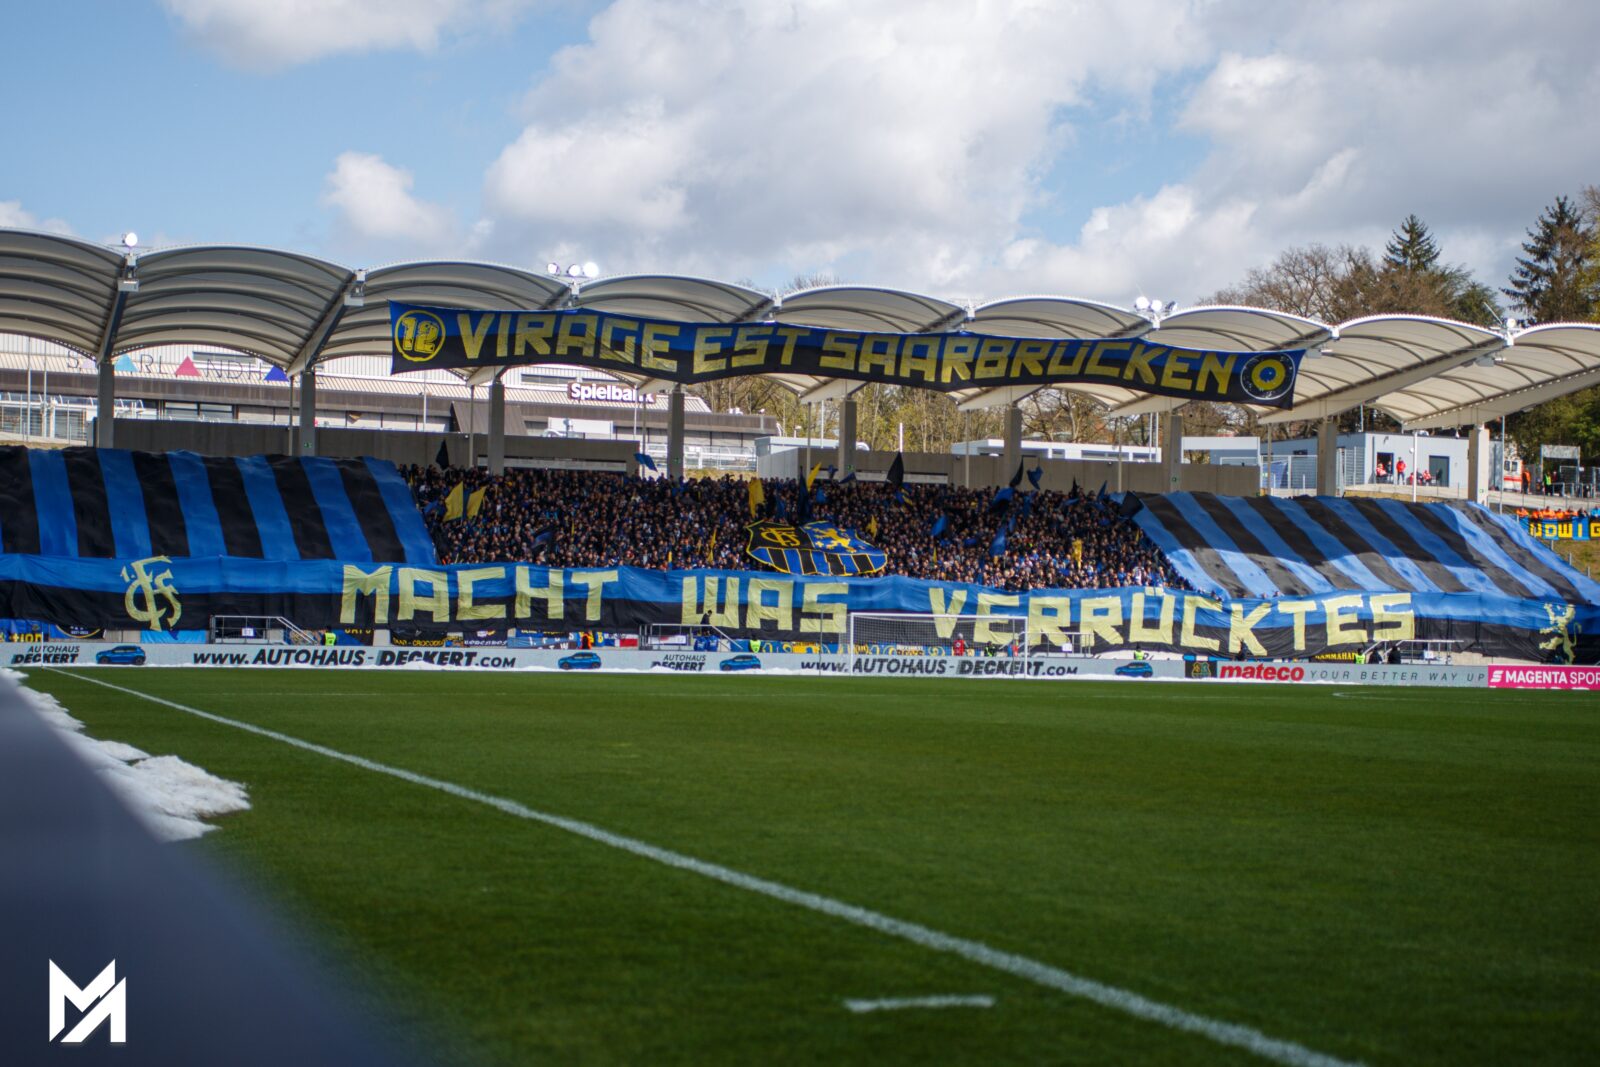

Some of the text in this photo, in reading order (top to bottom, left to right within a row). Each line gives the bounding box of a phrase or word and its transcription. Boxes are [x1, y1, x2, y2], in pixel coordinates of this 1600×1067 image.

[457, 313, 681, 373] VIRAGE
[693, 326, 811, 374] EST
[819, 332, 1239, 395] SAARBRÜCKEN
[340, 564, 1416, 657] MACHT WAS VERRÜCKTES
[28, 645, 80, 653] AUTOHAUS
[11, 653, 79, 664] DECKERT
[663, 654, 706, 662] AUTOHAUS
[1219, 663, 1305, 682] mateco
[1310, 670, 1486, 682] YOUR BETTER WAY UP
[1505, 671, 1568, 684] MAGENTA
